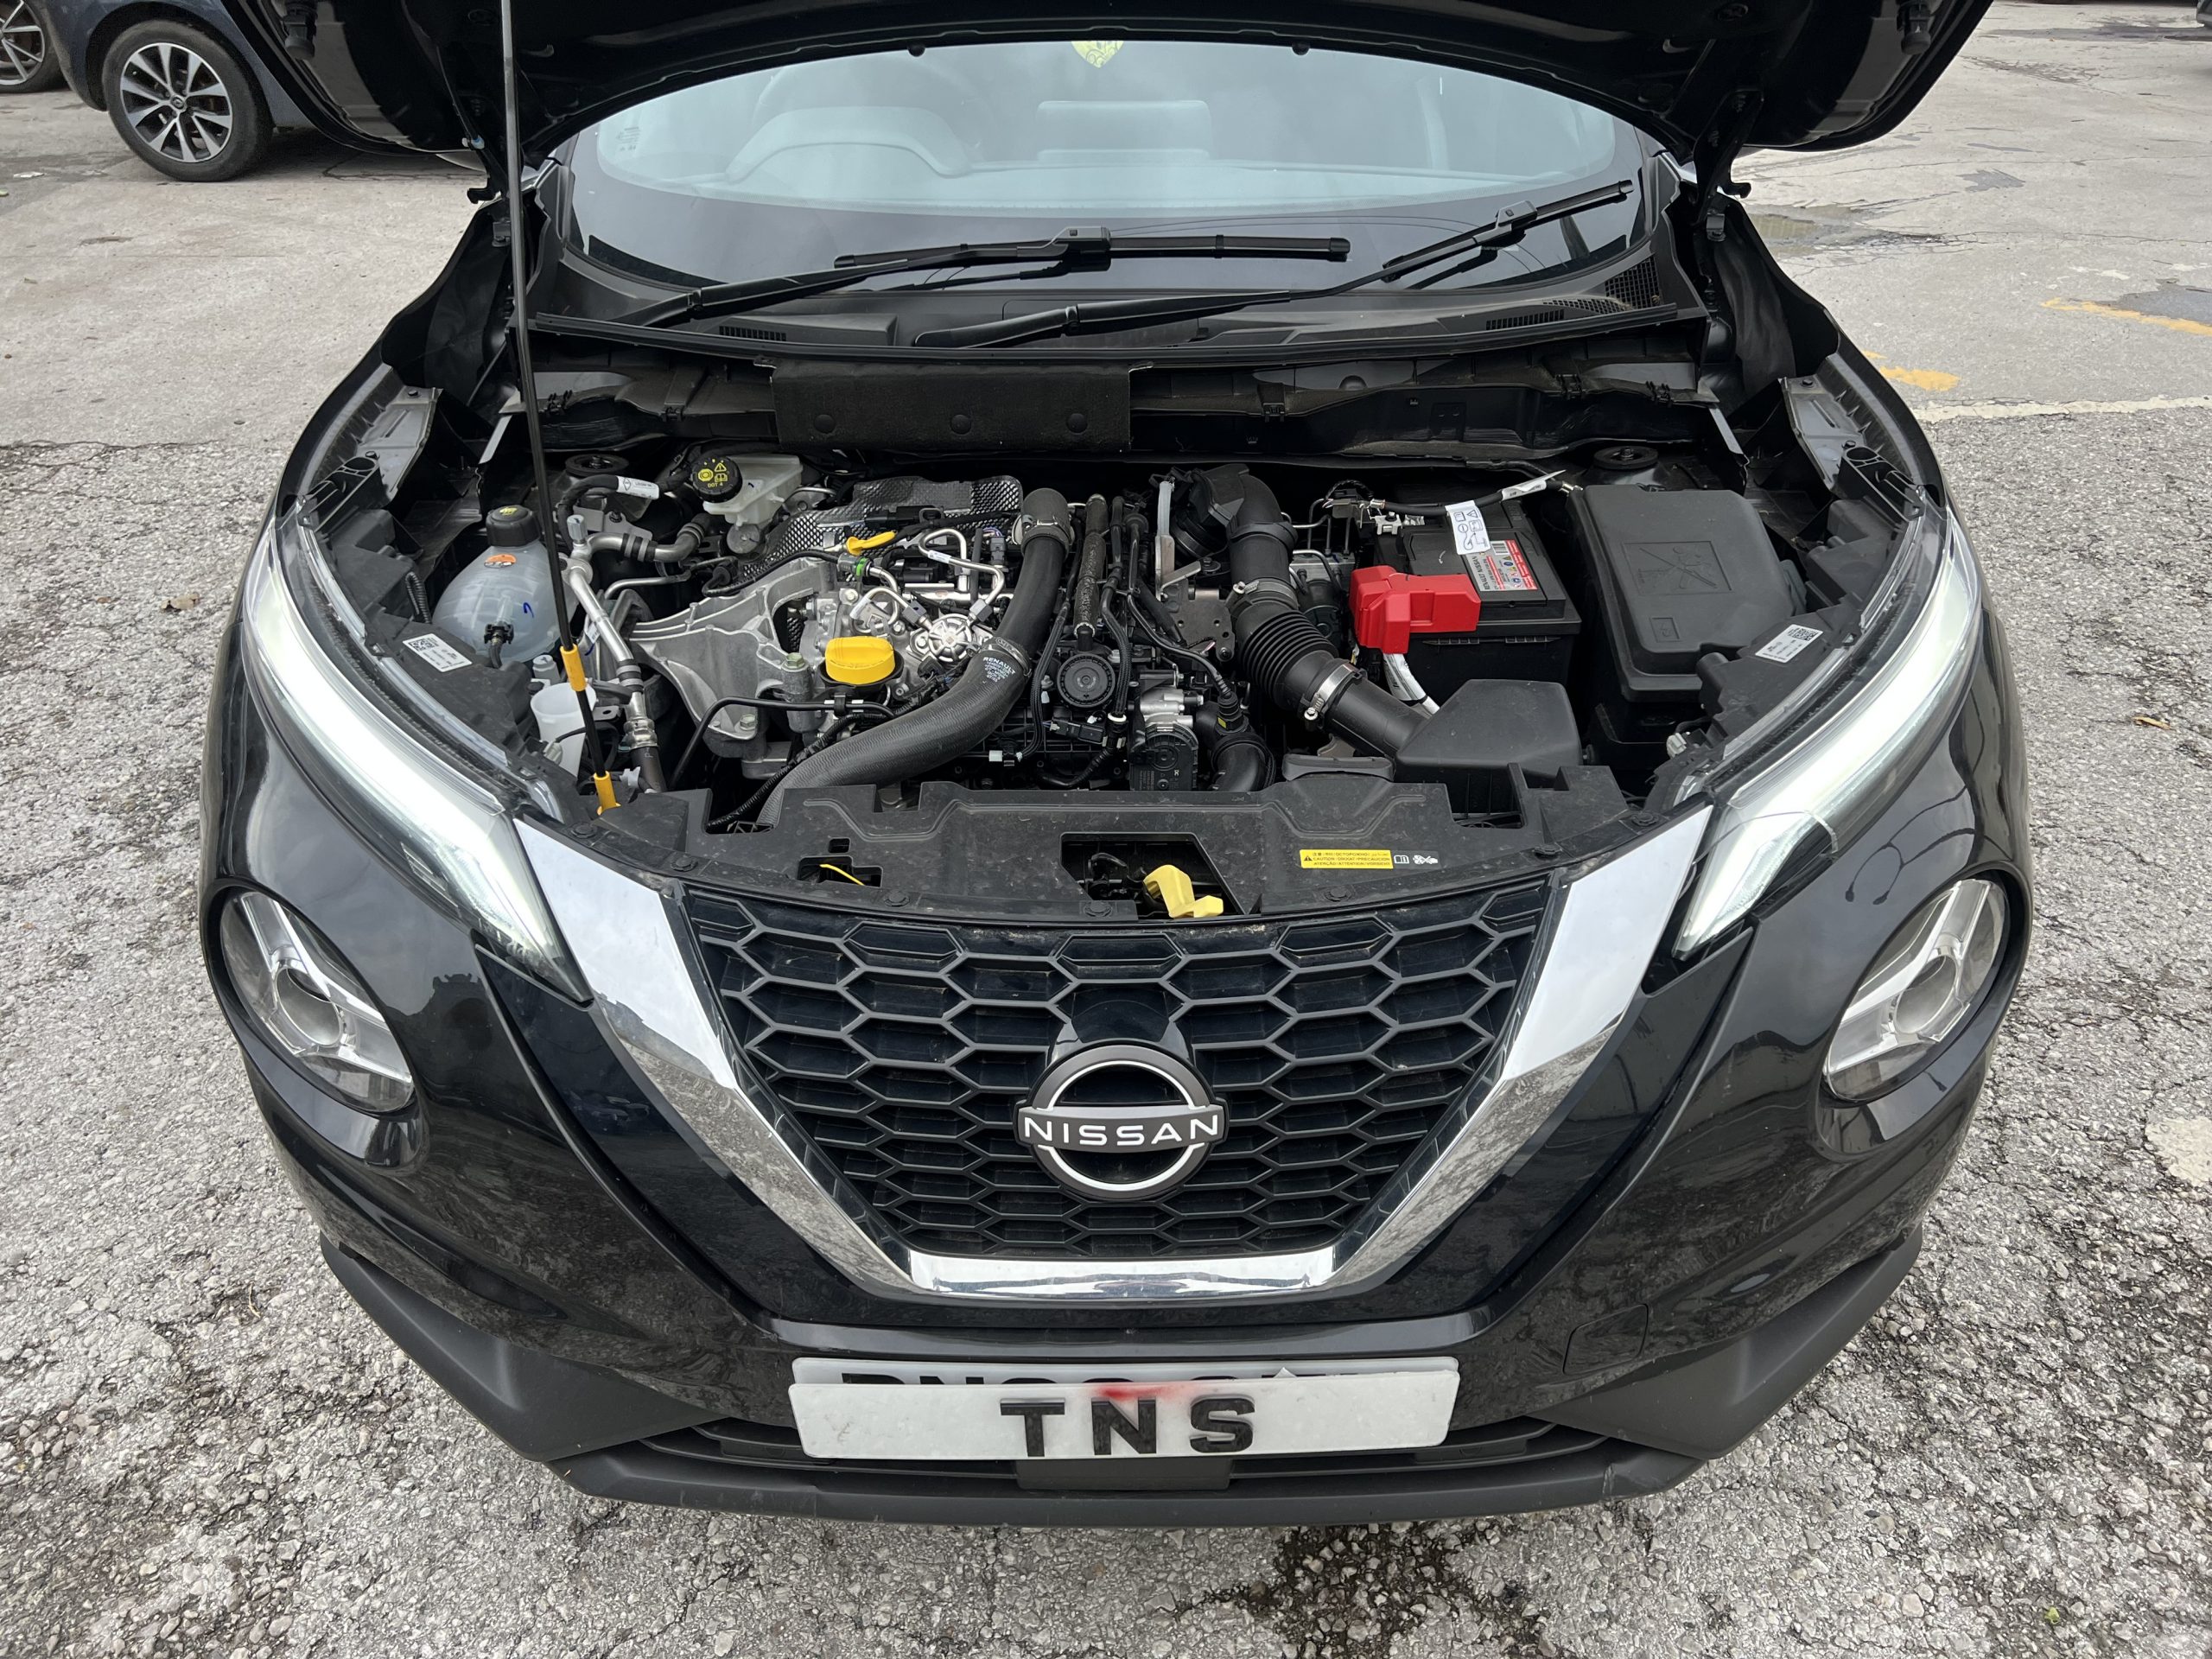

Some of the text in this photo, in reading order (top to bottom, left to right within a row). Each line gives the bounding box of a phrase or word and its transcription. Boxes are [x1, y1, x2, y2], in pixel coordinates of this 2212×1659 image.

[983, 657, 1015, 674] RENAULT
[1024, 1114, 1218, 1146] NISSAN
[1000, 1395, 1255, 1458] TNS
